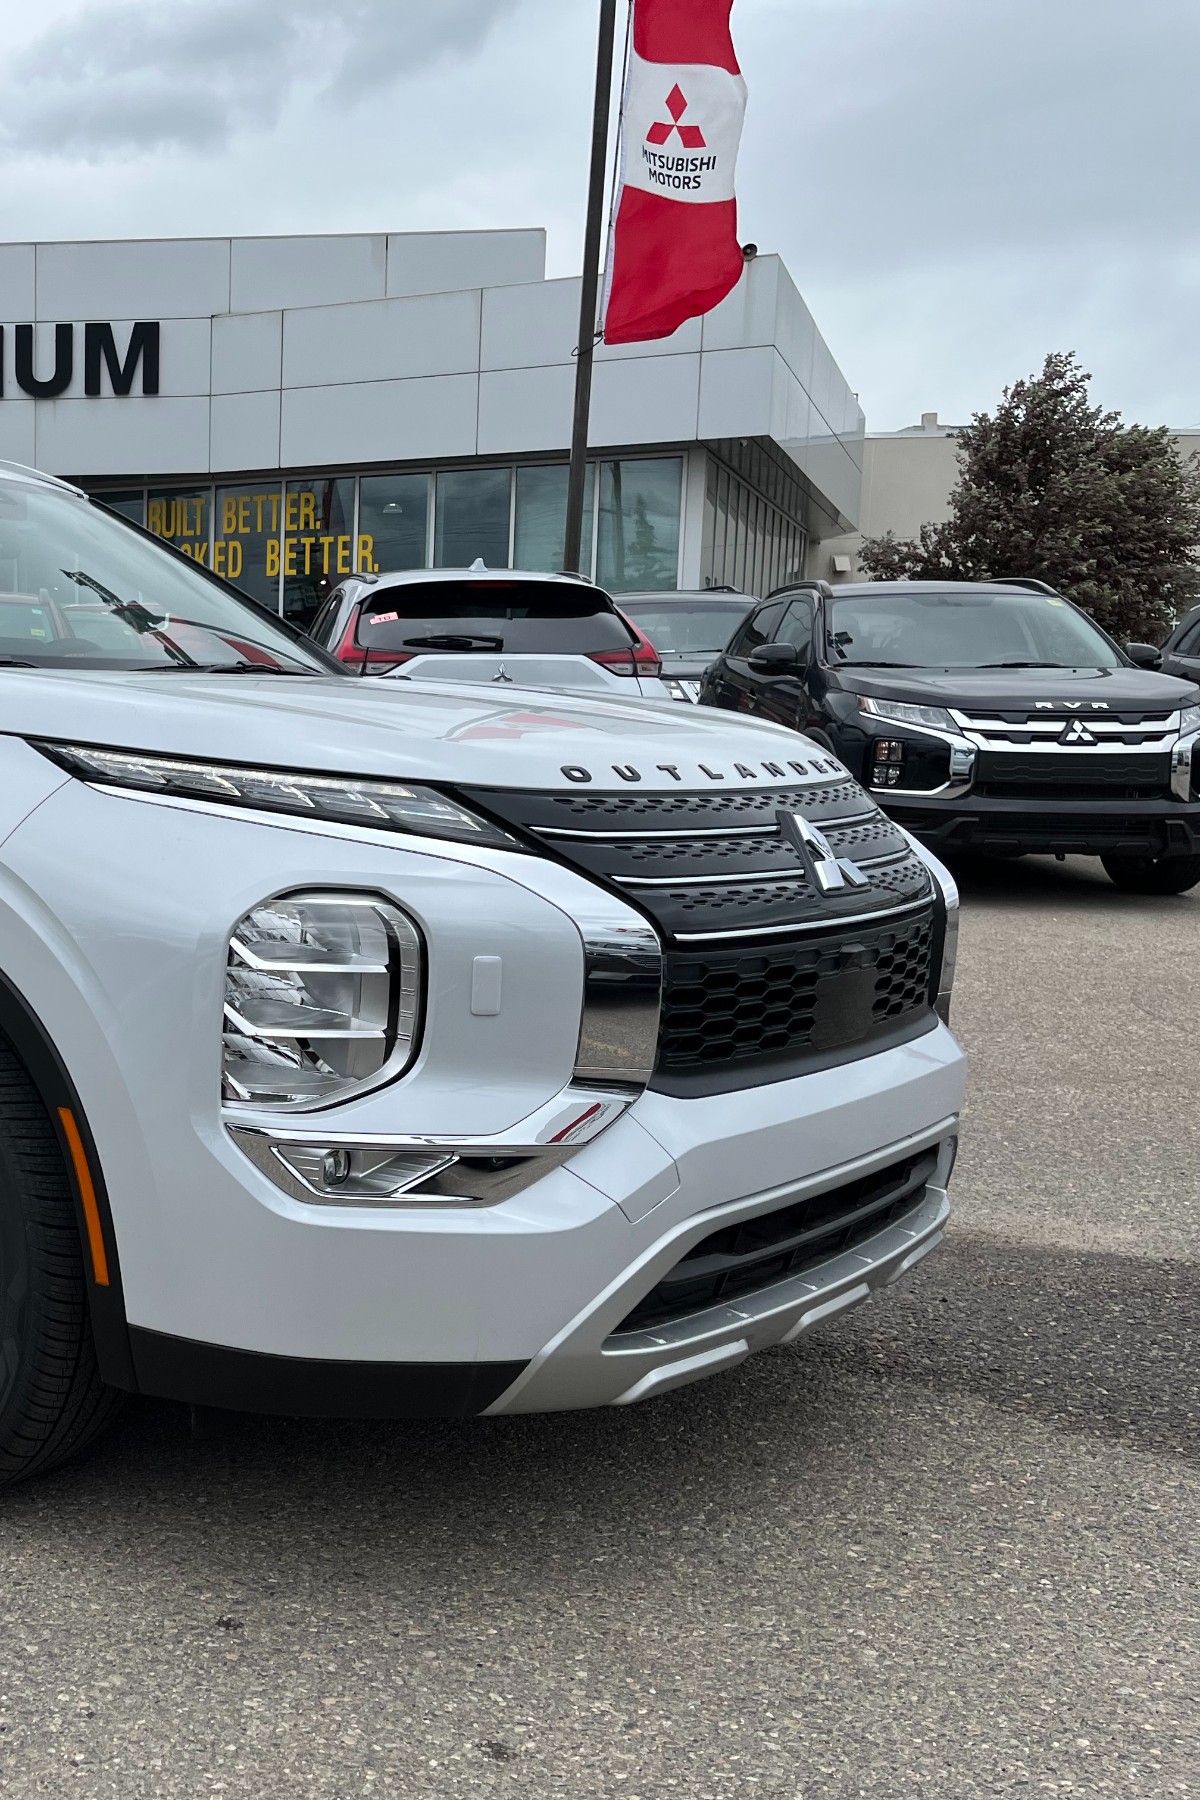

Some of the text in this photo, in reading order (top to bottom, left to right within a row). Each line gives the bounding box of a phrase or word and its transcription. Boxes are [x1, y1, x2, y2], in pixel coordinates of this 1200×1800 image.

[642, 145, 716, 172] MITSUBISHI
[648, 168, 702, 189] MOTORS
[148, 492, 321, 538] BUILT BETTER.
[181, 535, 379, 578] KED BETTER.
[1034, 701, 1110, 709] RVR
[560, 757, 843, 783] OUTLANDER
